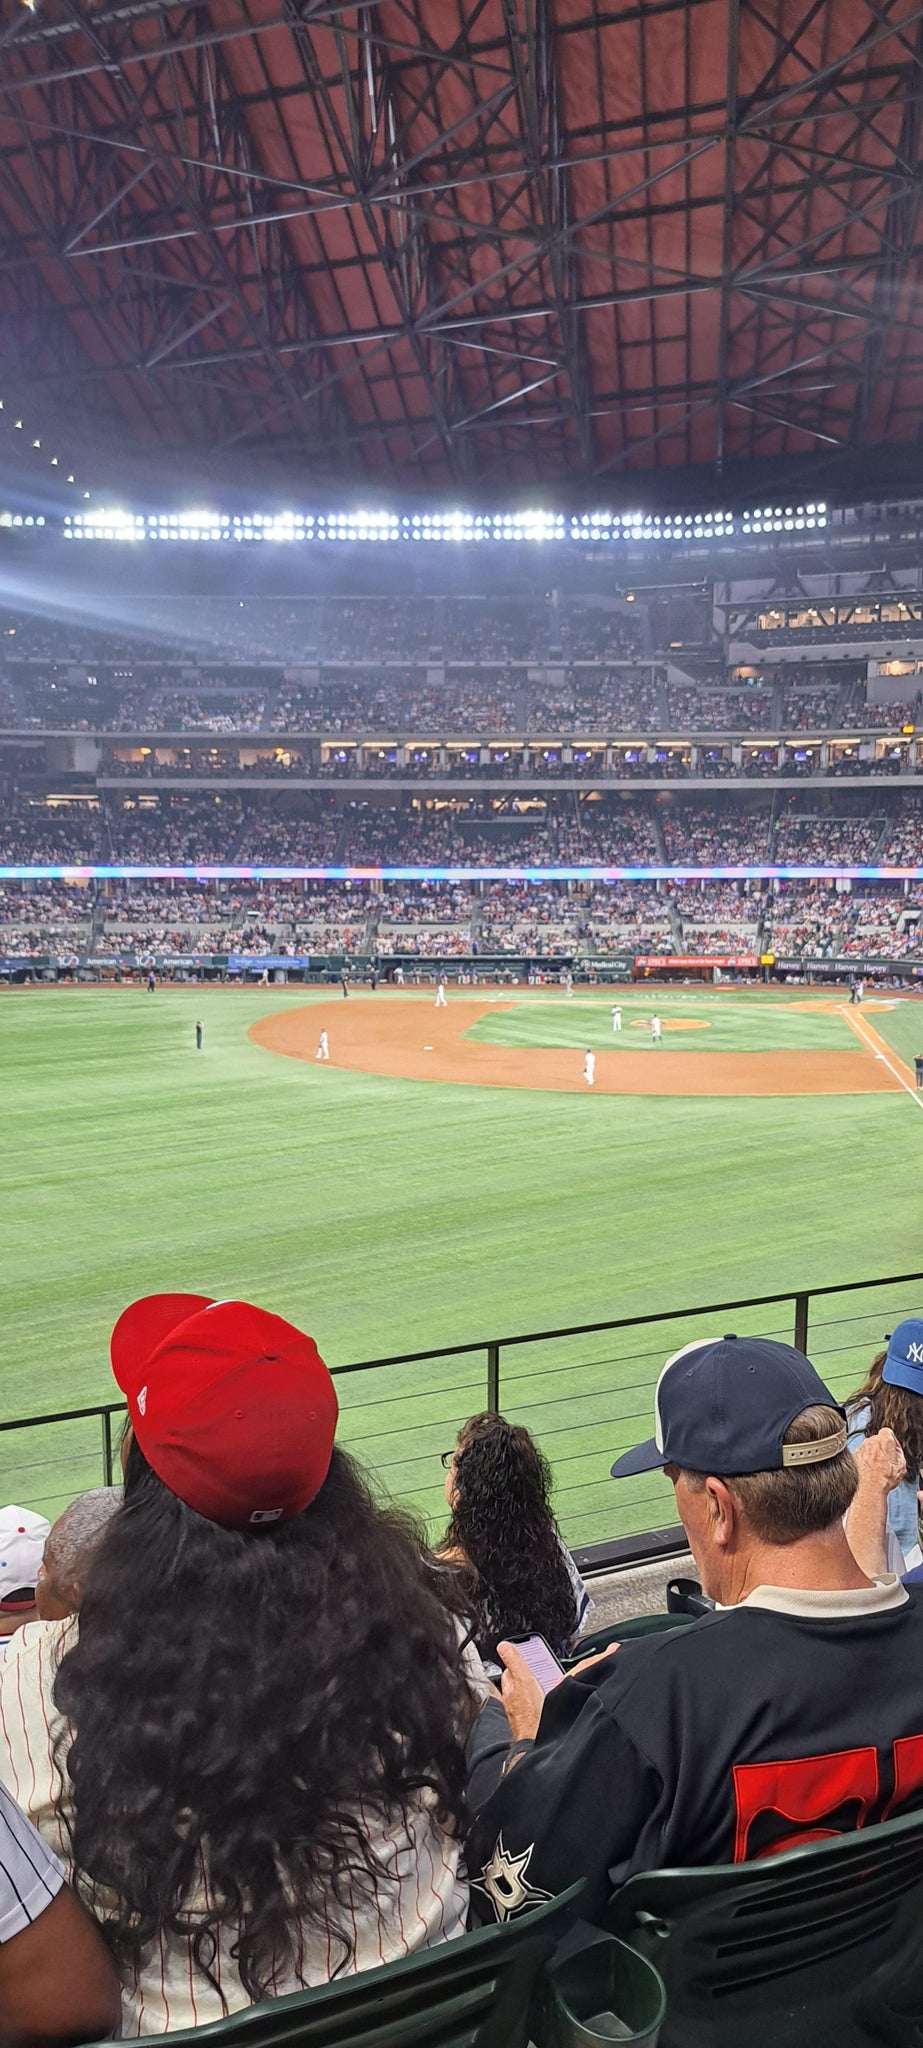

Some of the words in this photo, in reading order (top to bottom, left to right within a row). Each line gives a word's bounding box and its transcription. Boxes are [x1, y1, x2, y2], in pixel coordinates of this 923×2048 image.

[87, 957, 117, 965] American
[163, 957, 193, 965] American
[777, 961, 800, 970] Harvey
[807, 962, 830, 971] Harvey
[835, 963, 858, 972] Harvey
[863, 964, 887, 973] Harvey
